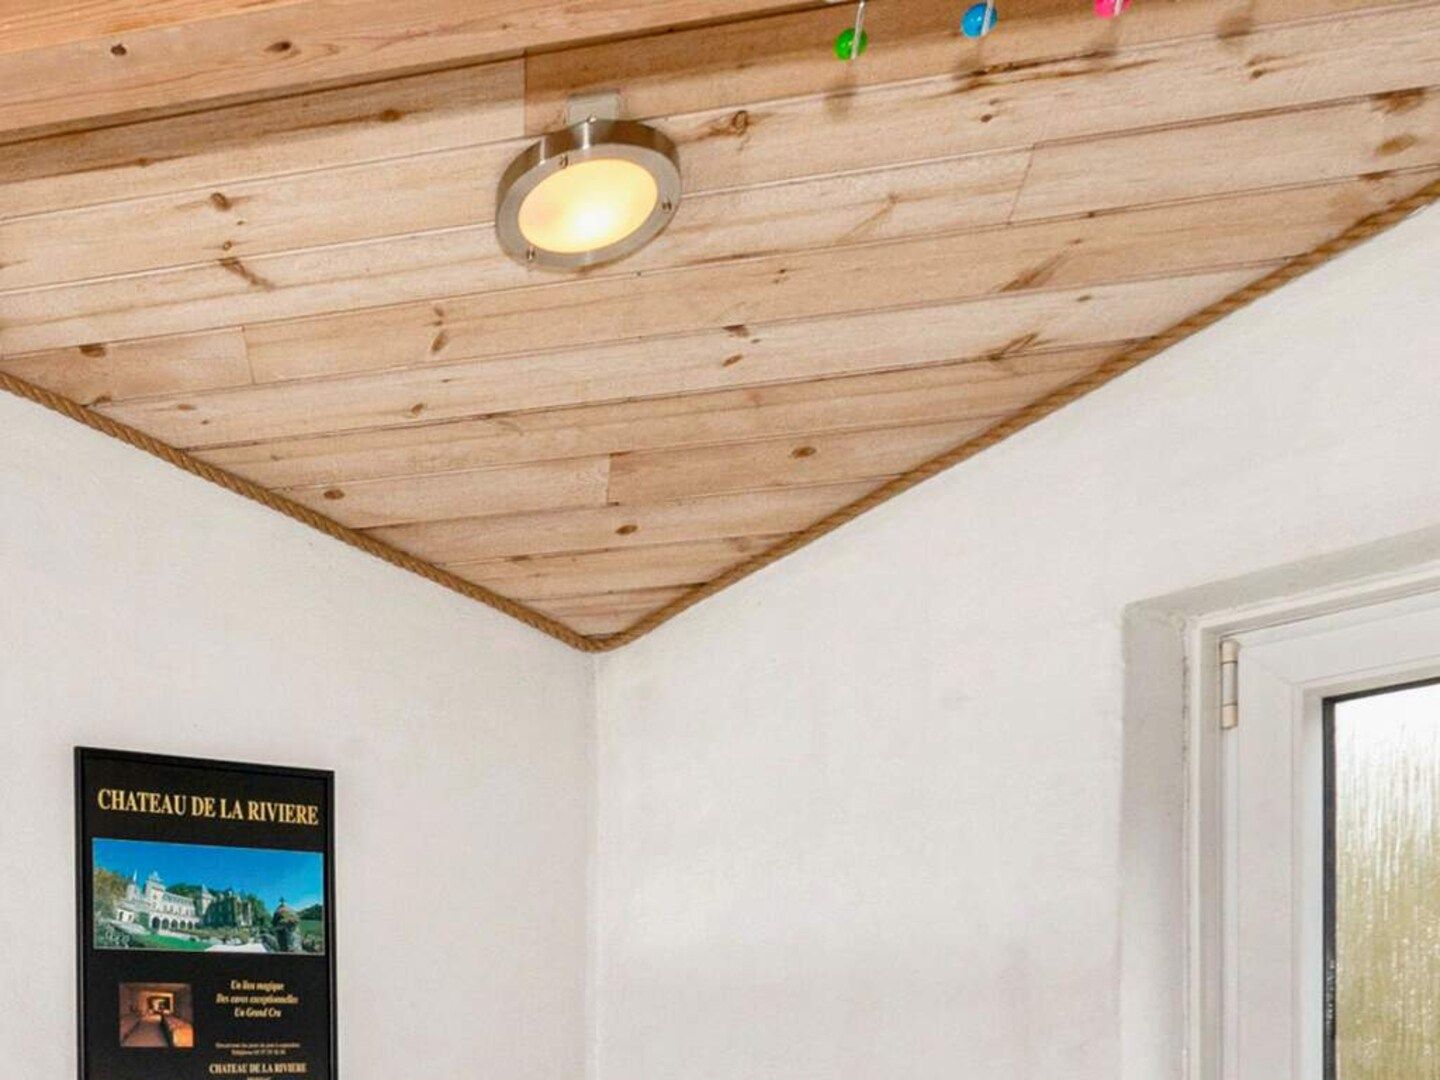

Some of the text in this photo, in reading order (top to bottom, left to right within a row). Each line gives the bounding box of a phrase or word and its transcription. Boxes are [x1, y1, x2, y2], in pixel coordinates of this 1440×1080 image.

[97, 788, 319, 825] CHATEAU DE LA RIVIERE
[262, 1063, 274, 1073] LA
